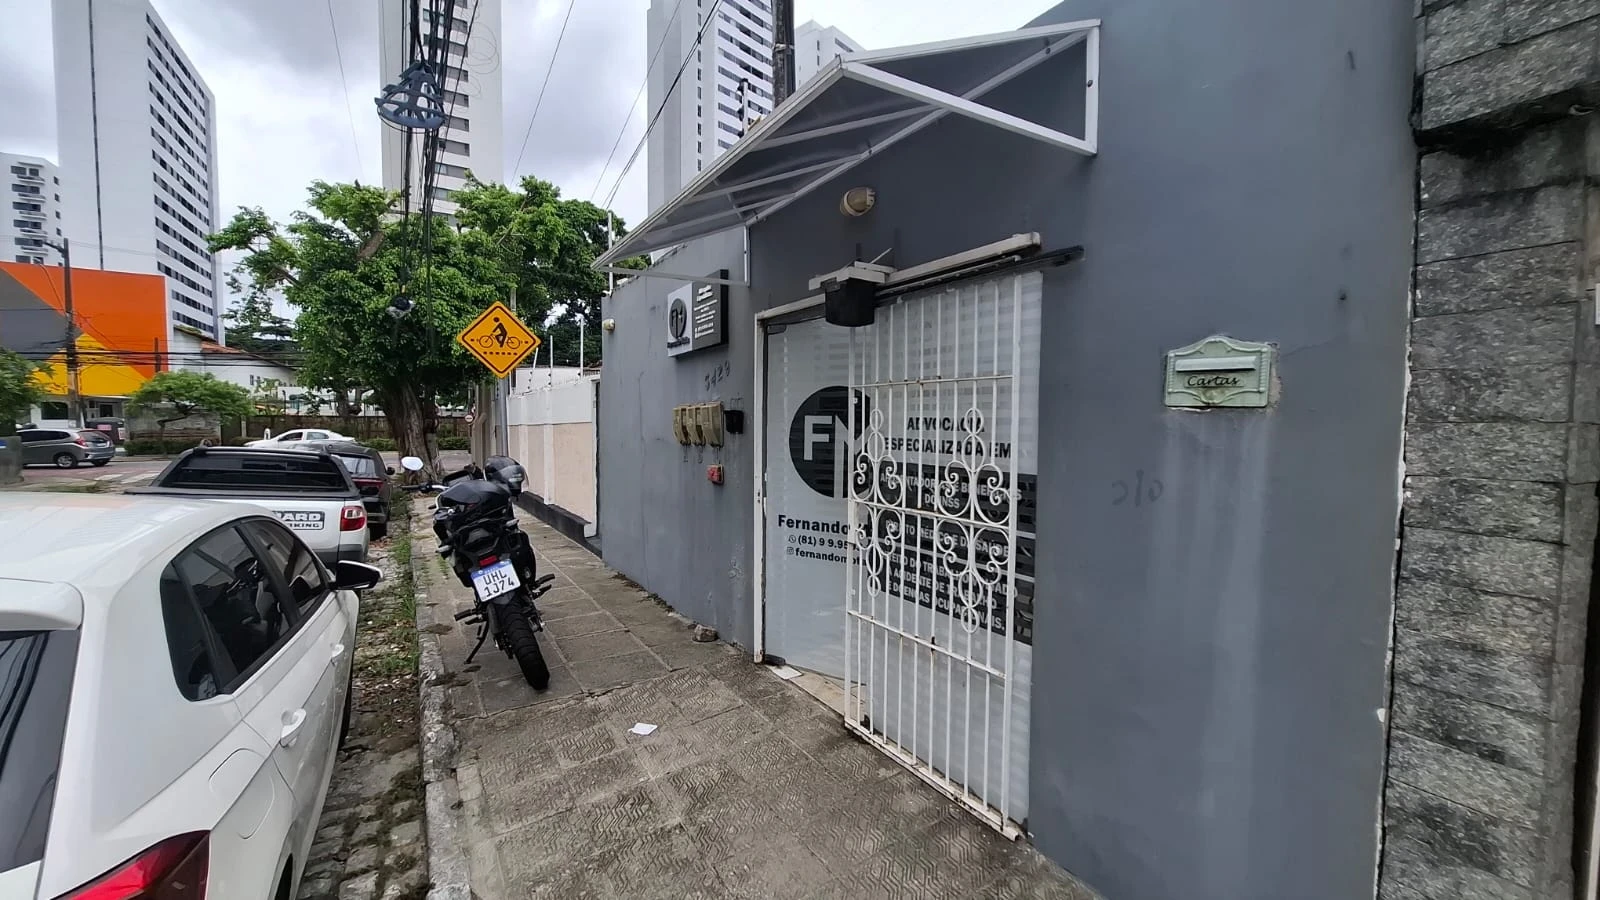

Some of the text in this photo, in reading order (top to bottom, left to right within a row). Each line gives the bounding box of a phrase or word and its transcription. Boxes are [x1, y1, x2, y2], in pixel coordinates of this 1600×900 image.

[1187, 375, 1240, 387] Cartas
[989, 442, 1011, 458] EM
[778, 514, 851, 535] Fernando
[798, 535, 817, 547] (81)
[819, 538, 825, 546] 9
[483, 570, 507, 585] UHL
[484, 577, 514, 597] 1J74
